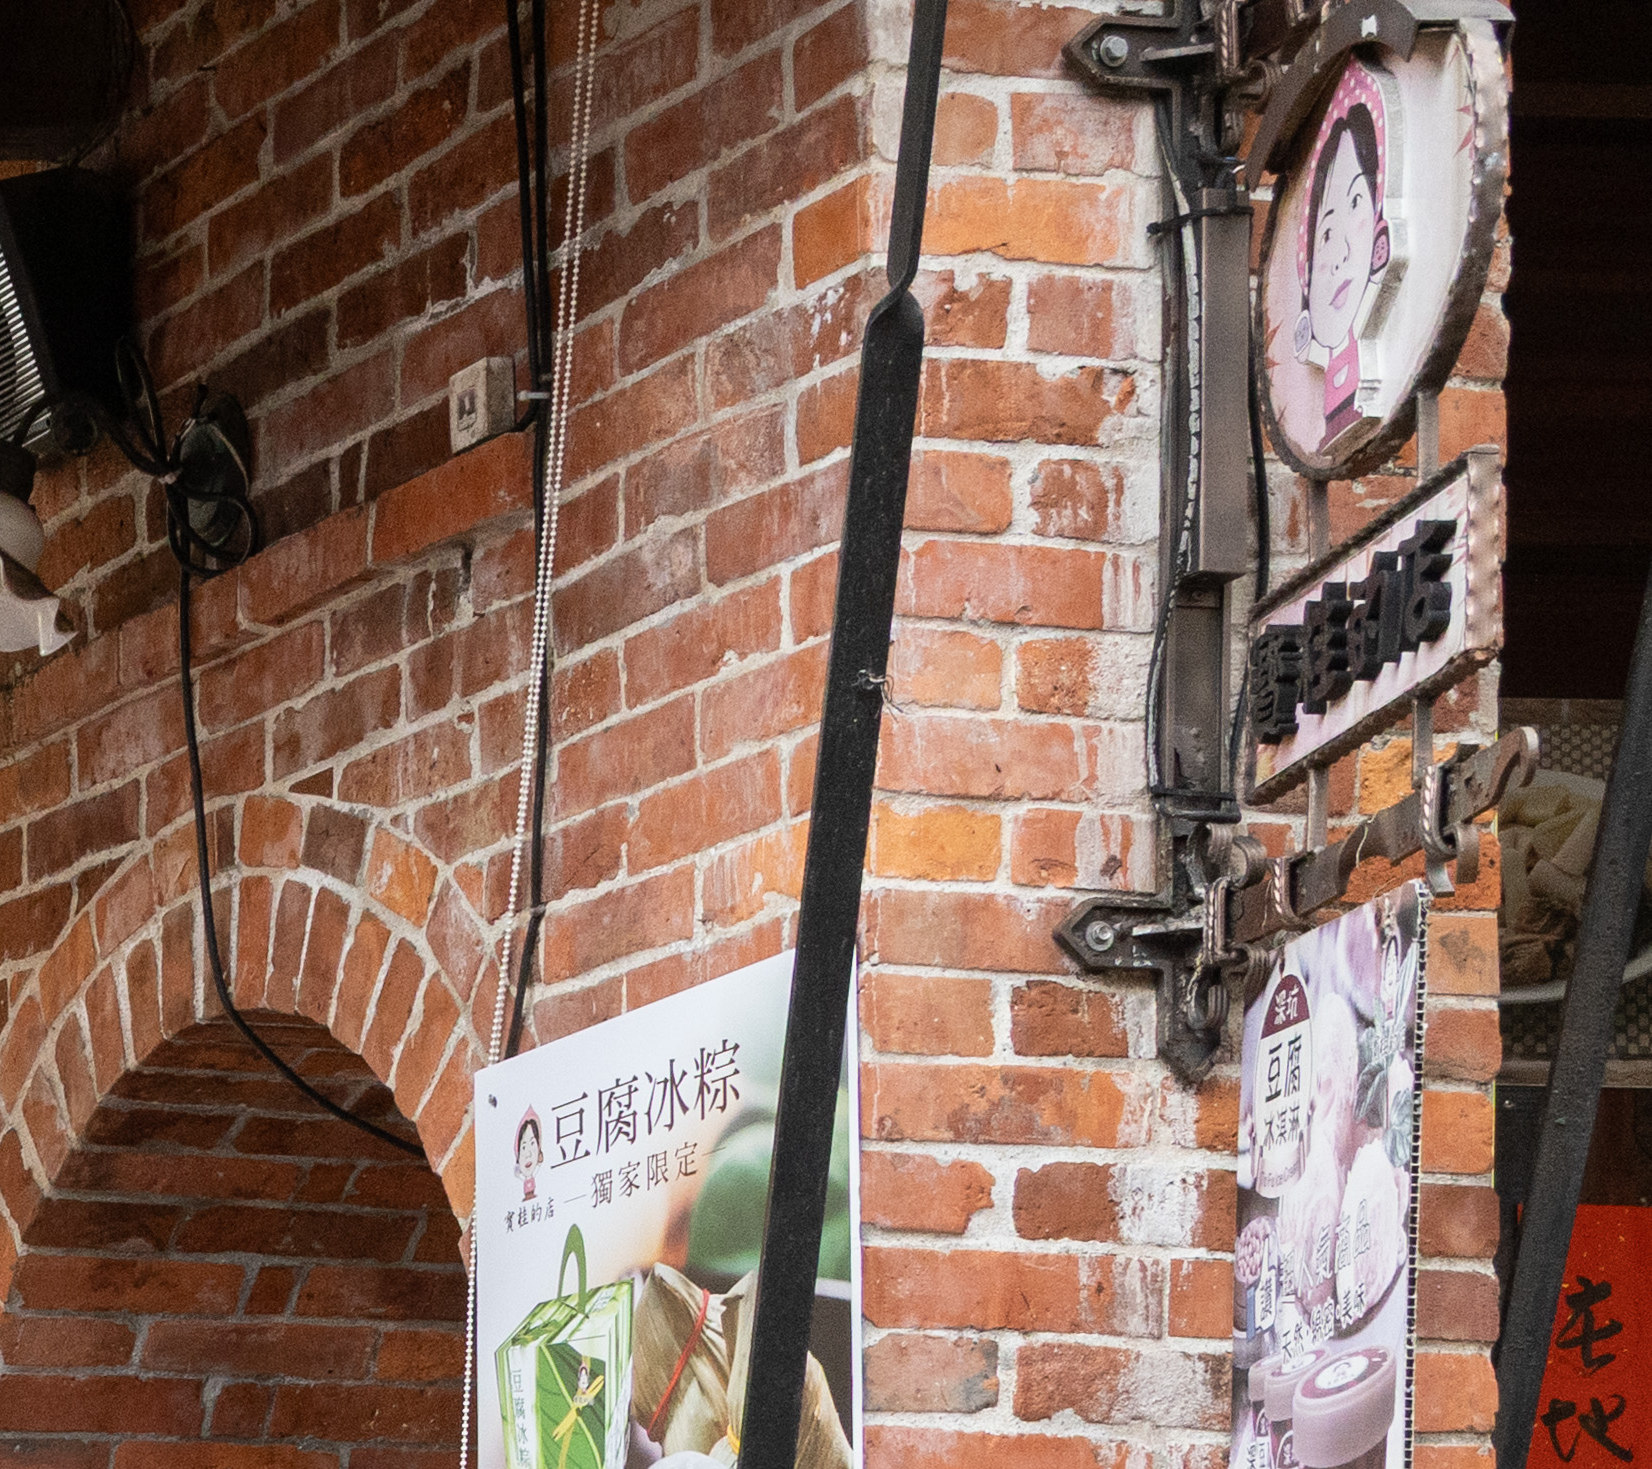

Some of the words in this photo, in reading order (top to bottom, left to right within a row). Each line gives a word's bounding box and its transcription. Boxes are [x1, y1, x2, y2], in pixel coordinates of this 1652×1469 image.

[548, 1037, 741, 1171] 豆腐冰粽
[1265, 1033, 1303, 1105] 豆腐
[591, 1143, 700, 1211] 獨家限定
[504, 1197, 554, 1235] 寶桂的店
